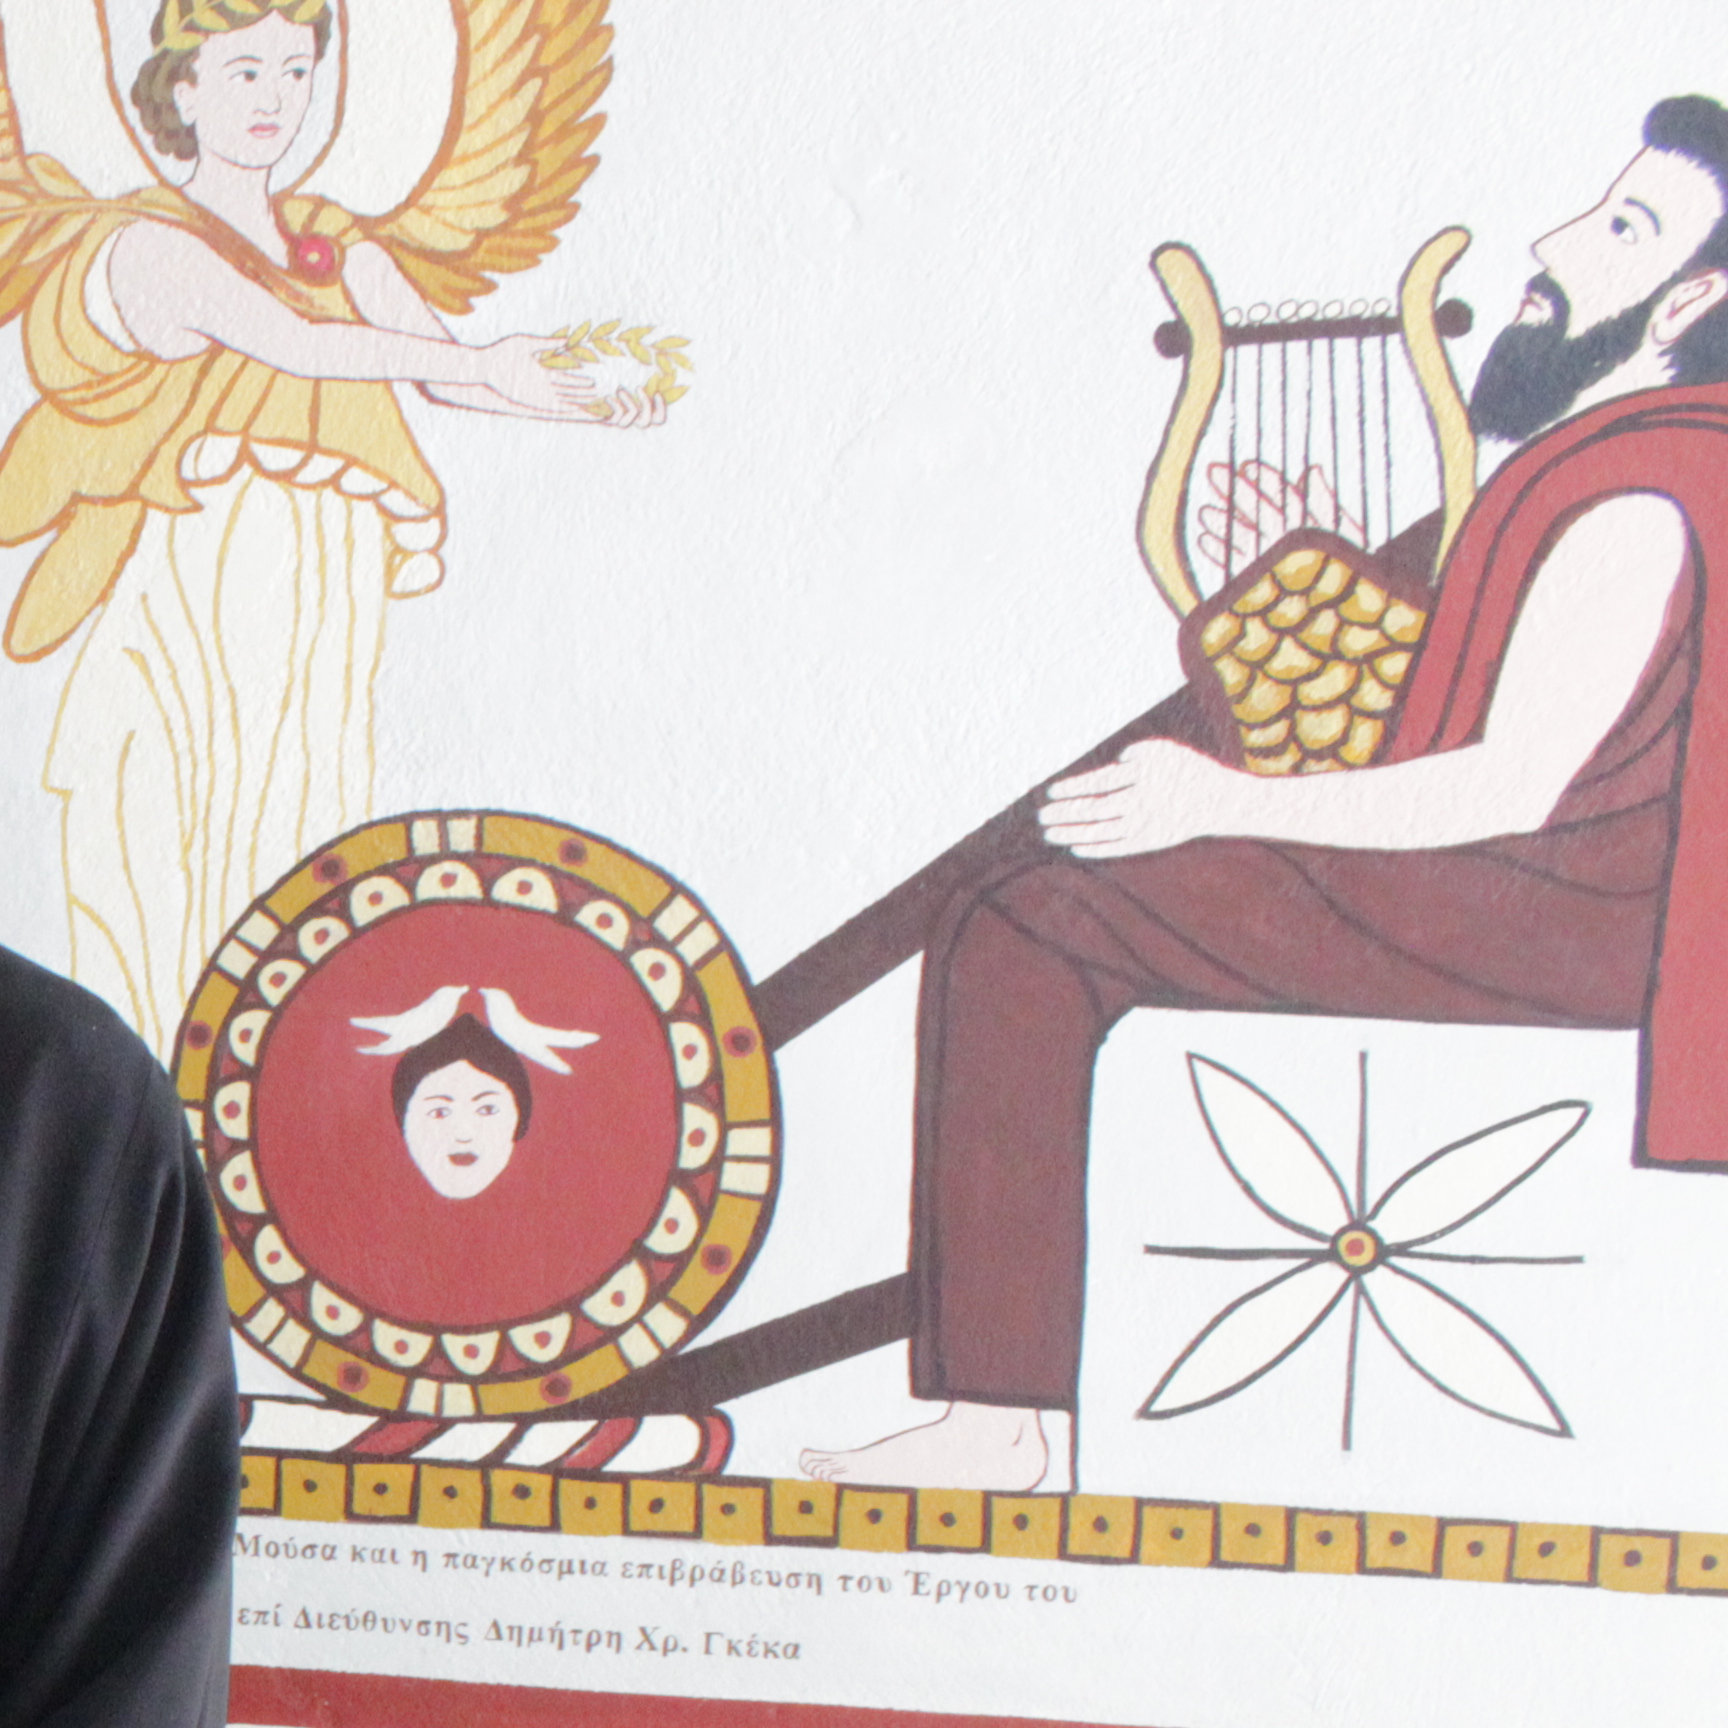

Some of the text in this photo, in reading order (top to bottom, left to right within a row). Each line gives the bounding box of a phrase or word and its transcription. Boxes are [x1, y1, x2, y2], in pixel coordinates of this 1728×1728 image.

[232, 1533, 1078, 1604] Μούσα και η παγκόσμια επιβράβευση του Έργου του
[236, 1603, 803, 1661] επί Διεύθυνσης Δημήτρη Χρ. Γκέκα
